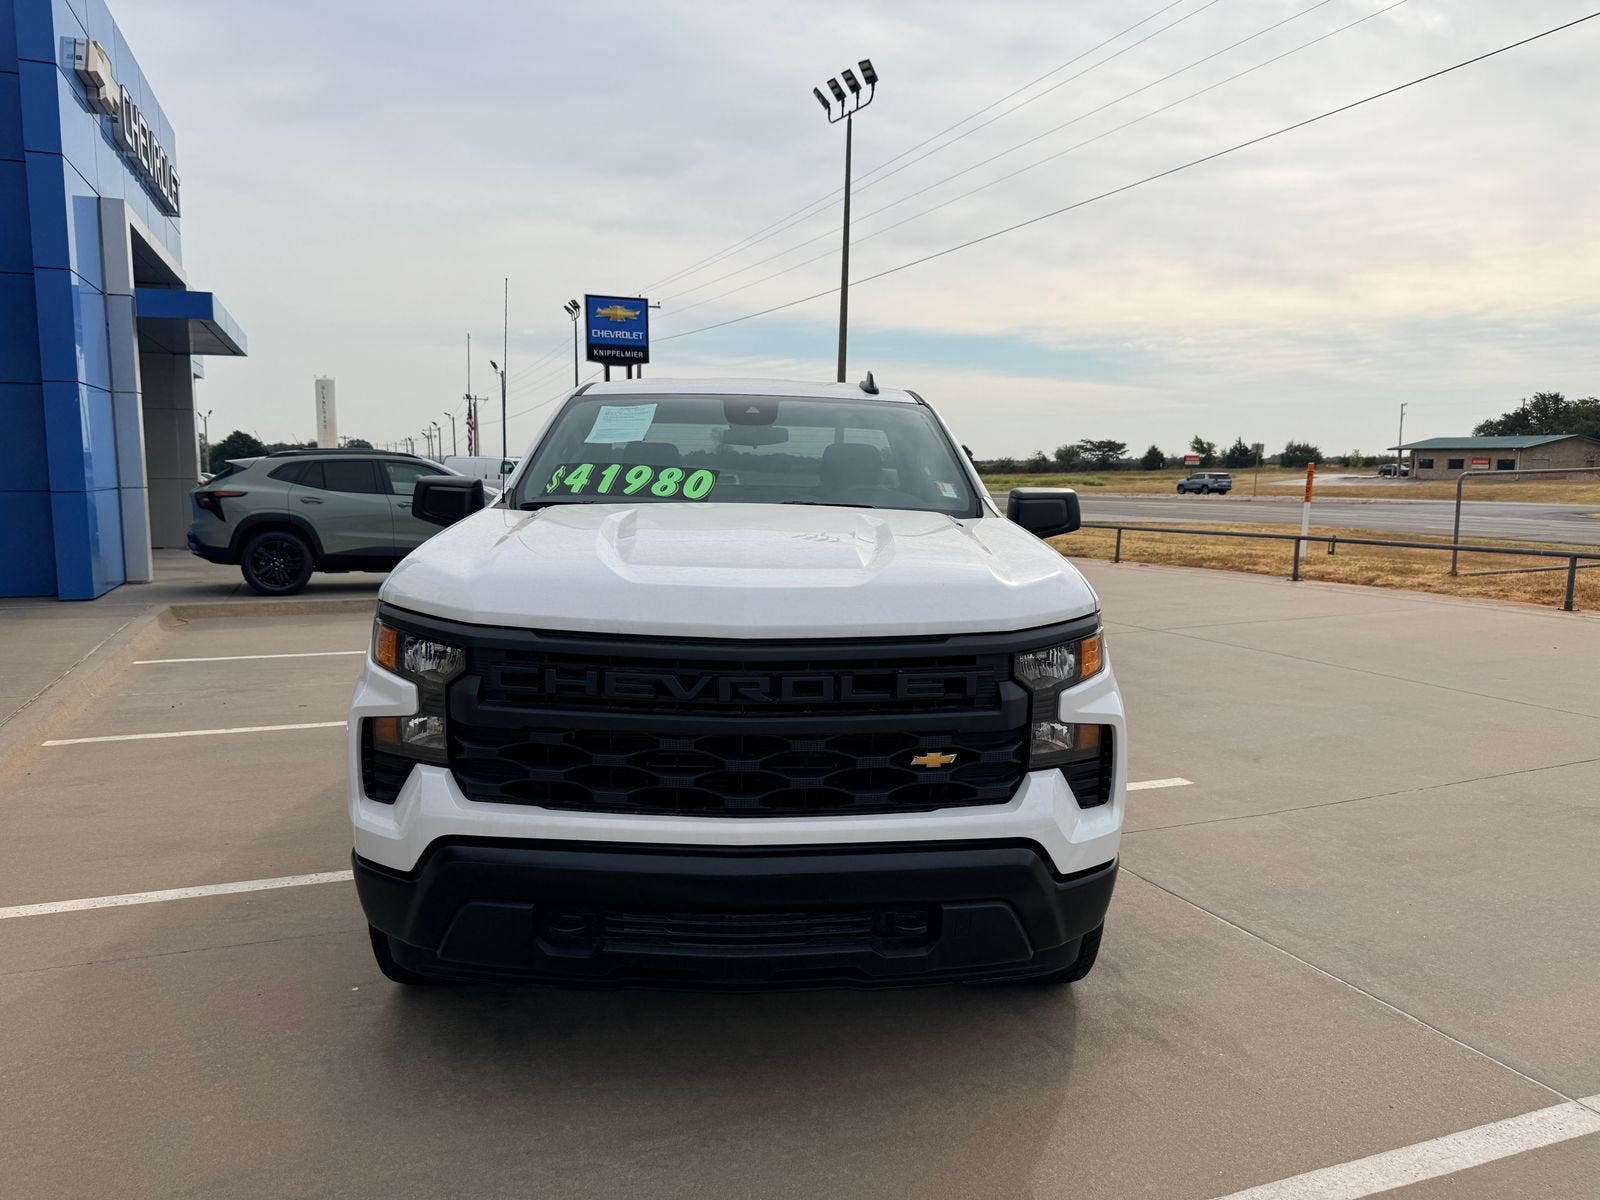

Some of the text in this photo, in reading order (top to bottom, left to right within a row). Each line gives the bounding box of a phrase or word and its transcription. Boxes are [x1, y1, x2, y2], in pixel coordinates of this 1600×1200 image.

[591, 329, 644, 340] CHEVROLET
[593, 349, 644, 358] KNIPPELMIER
[546, 463, 715, 500] $41980
[494, 665, 995, 703] CHEVROLET
